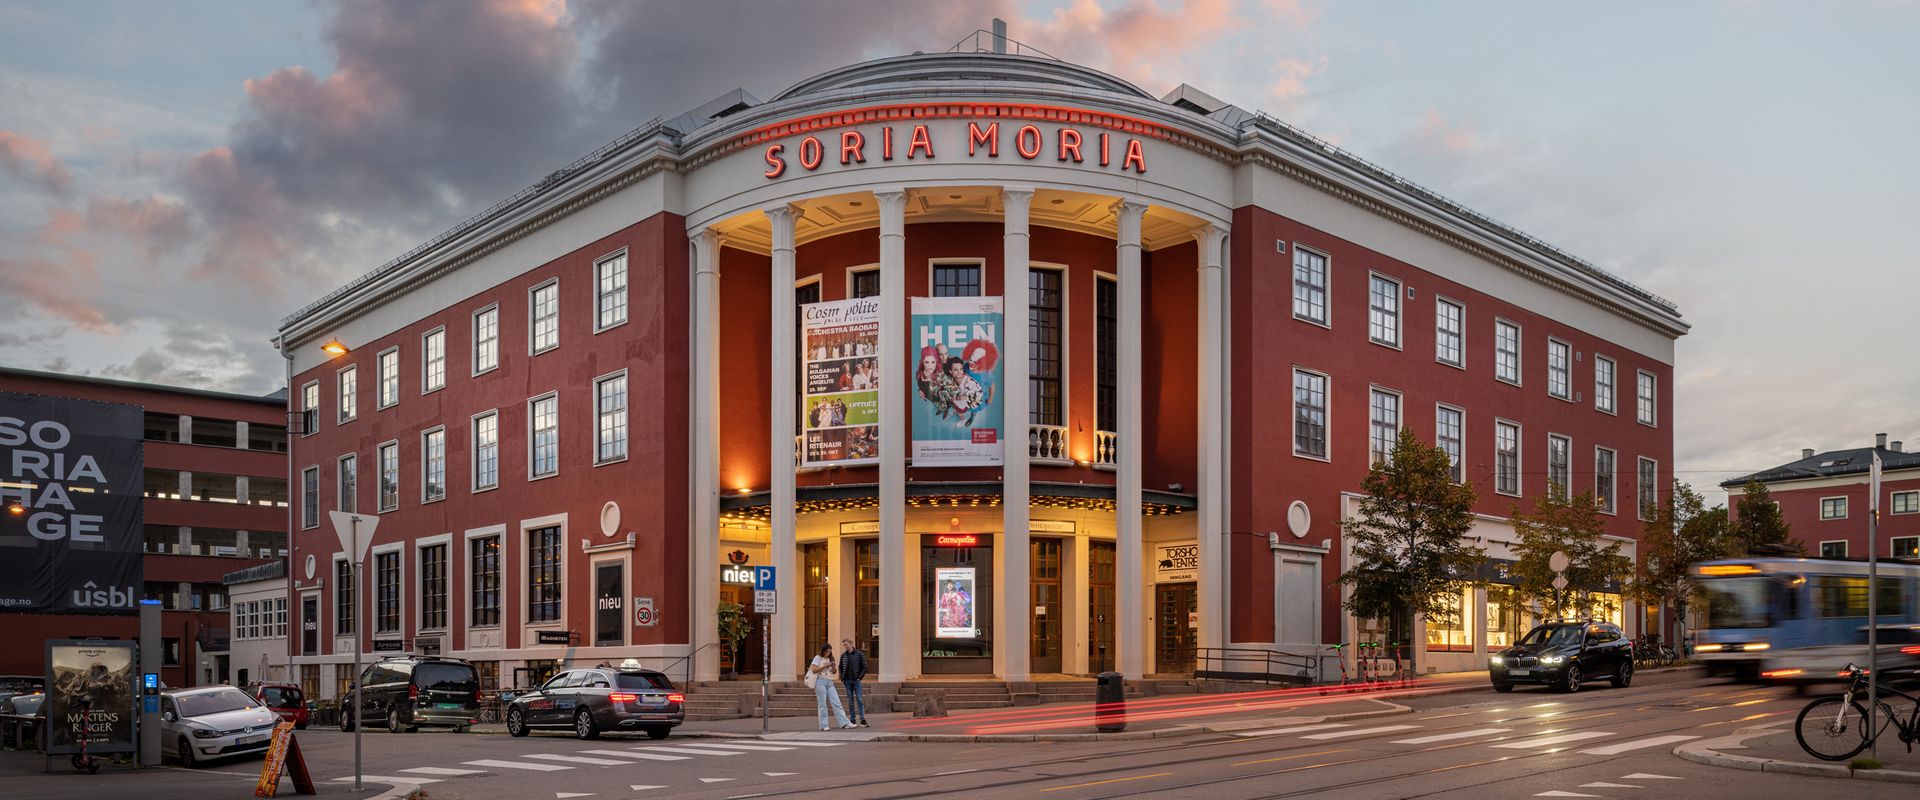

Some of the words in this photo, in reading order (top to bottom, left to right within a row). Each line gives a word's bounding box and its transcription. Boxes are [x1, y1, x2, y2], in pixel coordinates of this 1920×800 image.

[764, 124, 935, 179] SORIA
[968, 121, 1147, 173] MORIA
[807, 327, 848, 336] CHESTRA
[850, 323, 878, 332] BAOBAB
[920, 325, 995, 348] HEN
[0, 416, 71, 450] SO
[809, 441, 842, 449] RITENAUR
[12, 449, 108, 484] RIA
[0, 479, 76, 511] HA
[27, 511, 104, 542] GE
[938, 535, 976, 546] Cosmopolite
[1173, 557, 1198, 568] TEATRE
[760, 569, 771, 587] P
[599, 594, 621, 610] nieu
[640, 611, 649, 620] 30
[73, 722, 113, 732] RNGER
